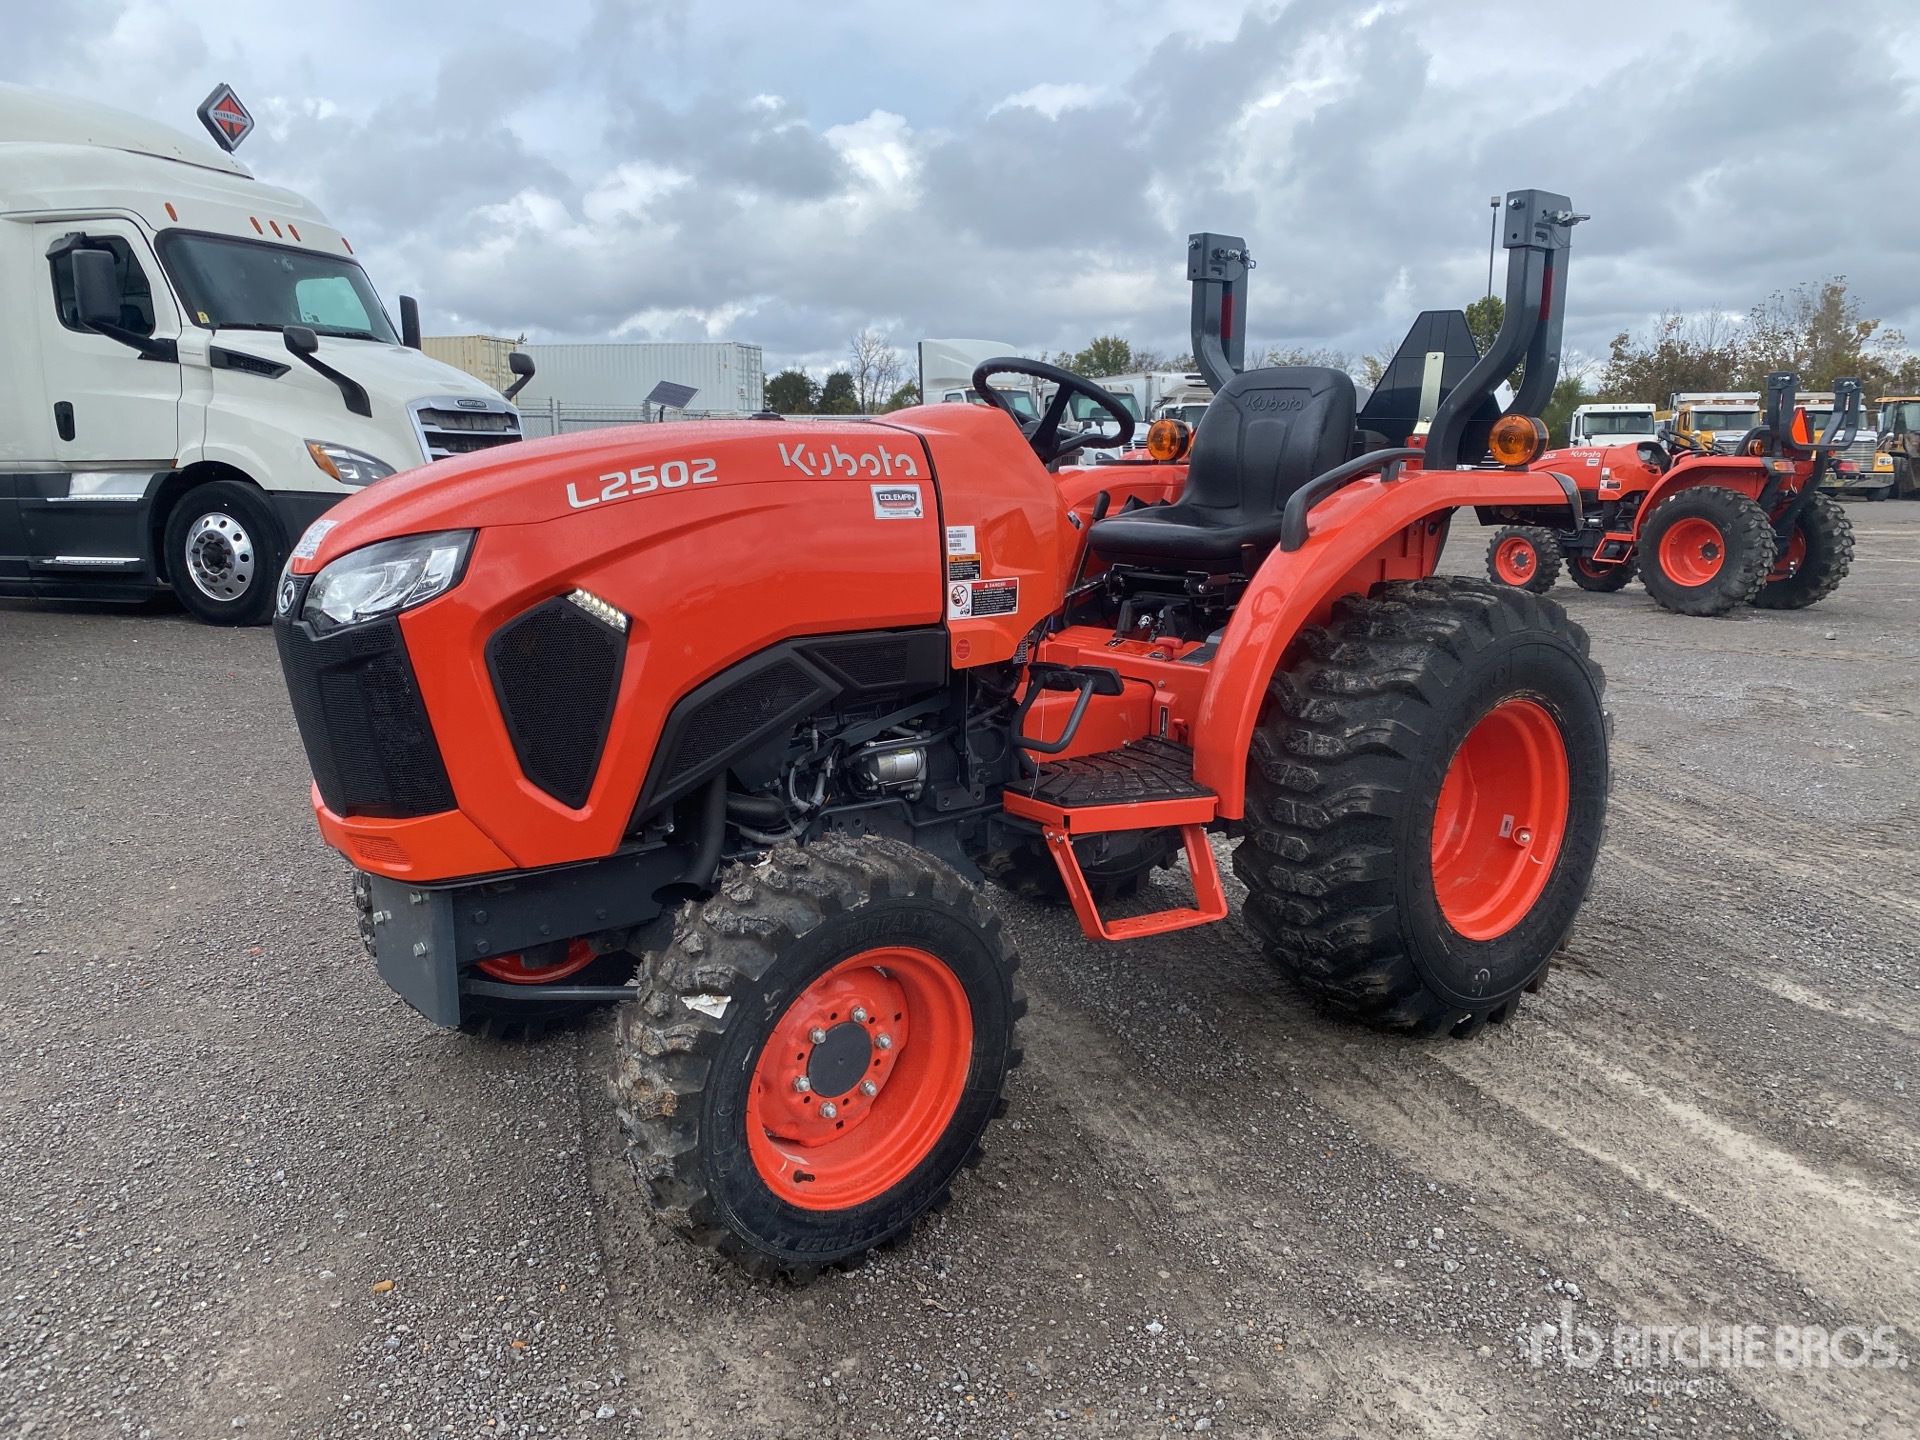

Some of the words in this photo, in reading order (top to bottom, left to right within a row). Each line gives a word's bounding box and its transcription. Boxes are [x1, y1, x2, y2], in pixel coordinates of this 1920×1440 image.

[1246, 395, 1303, 411] Kubota
[778, 443, 919, 477] Kubota
[1570, 450, 1601, 458] Kubota
[566, 458, 718, 509] L2502
[879, 493, 915, 501] COLEMAN
[840, 911, 934, 948] TITAN
